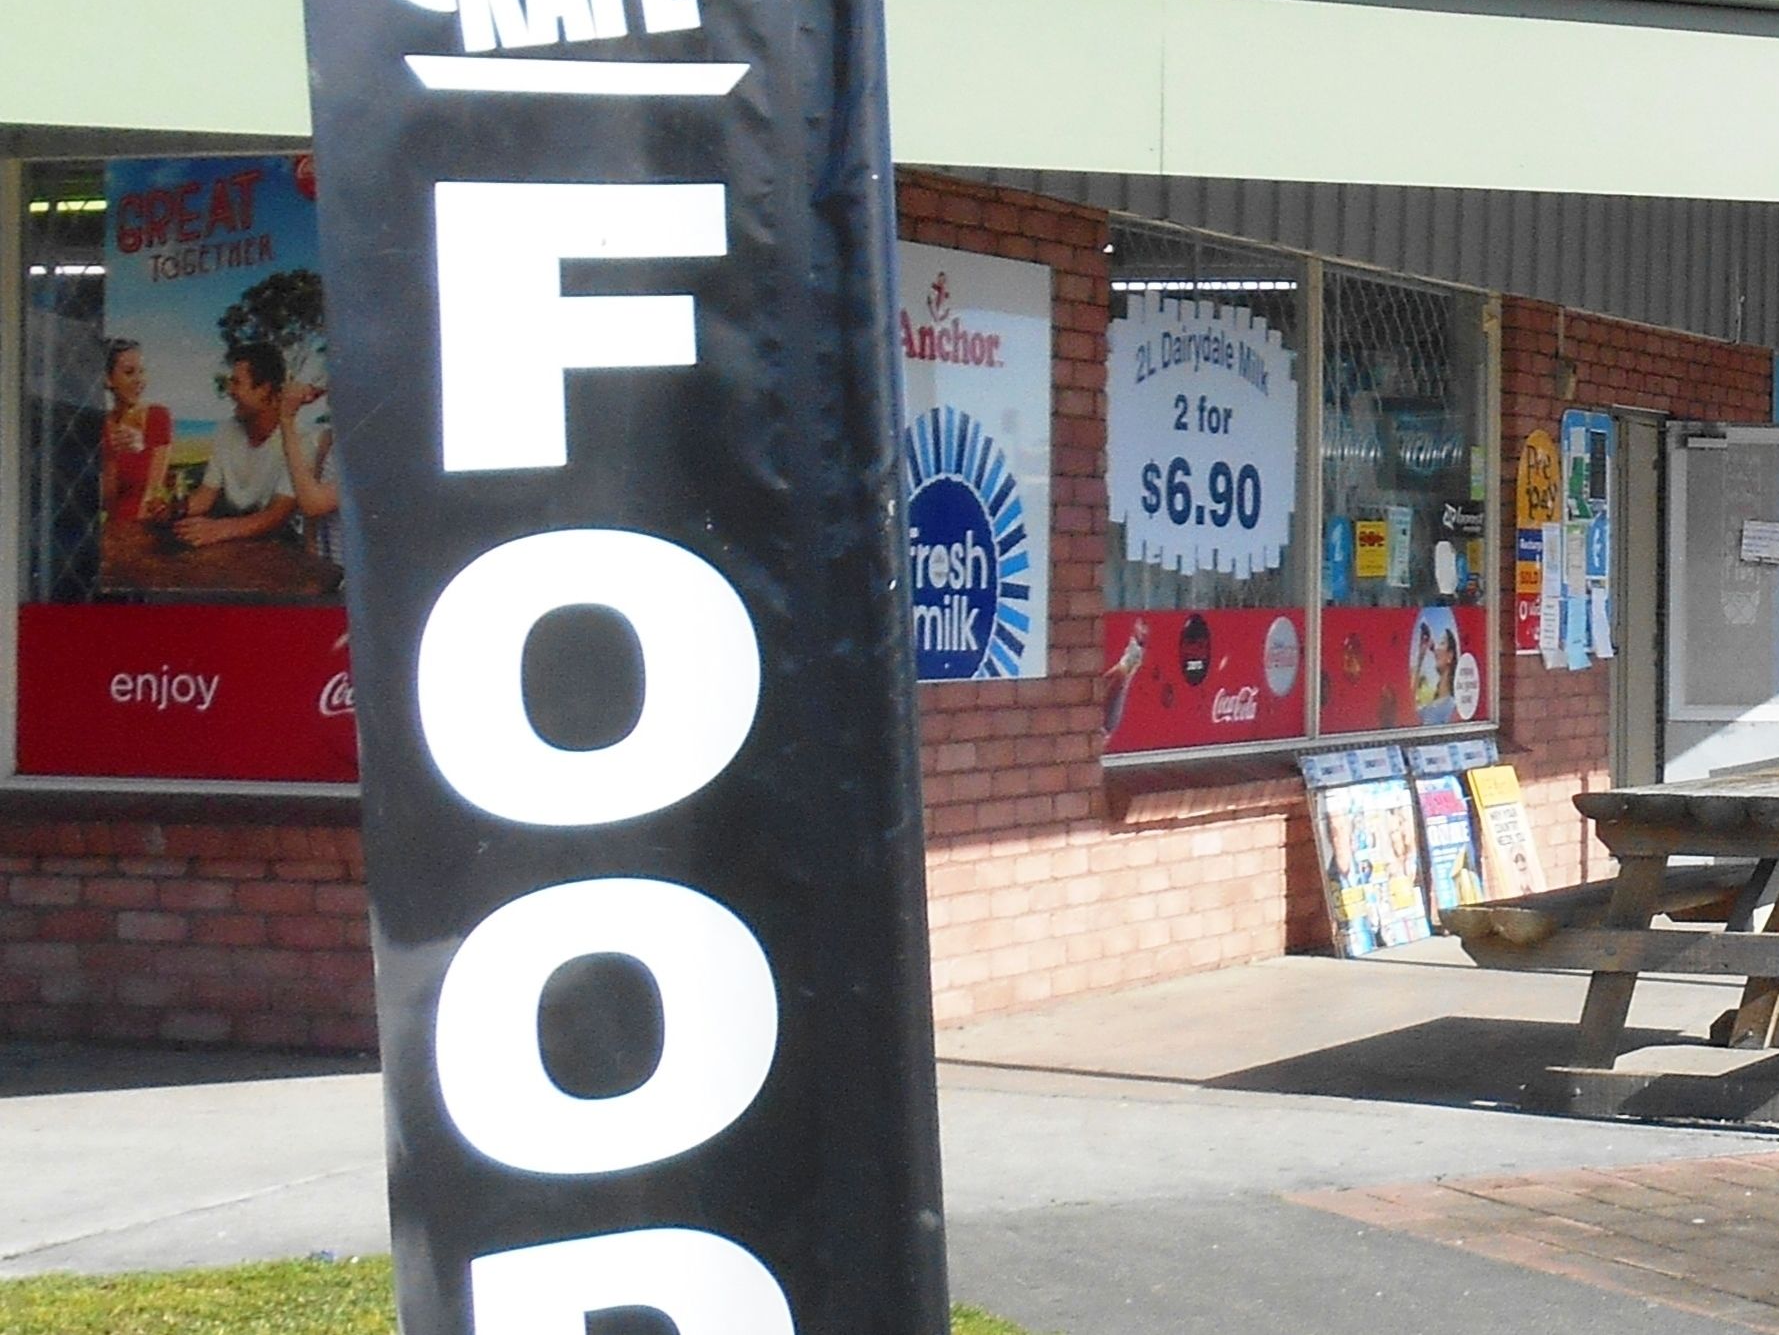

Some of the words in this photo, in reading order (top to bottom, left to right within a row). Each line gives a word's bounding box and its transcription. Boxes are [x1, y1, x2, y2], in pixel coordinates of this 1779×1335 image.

[116, 169, 264, 254] GREAT
[900, 307, 1000, 367] Anchor
[1136, 340, 1157, 384] 2L
[1161, 325, 1234, 372] Dairydale
[1174, 394, 1189, 431] 2
[1198, 395, 1233, 435] for
[1141, 456, 1262, 531] $6.90
[912, 594, 980, 652] milk
[110, 664, 220, 711] enjoy
[1211, 685, 1259, 724] Coca-Cola
